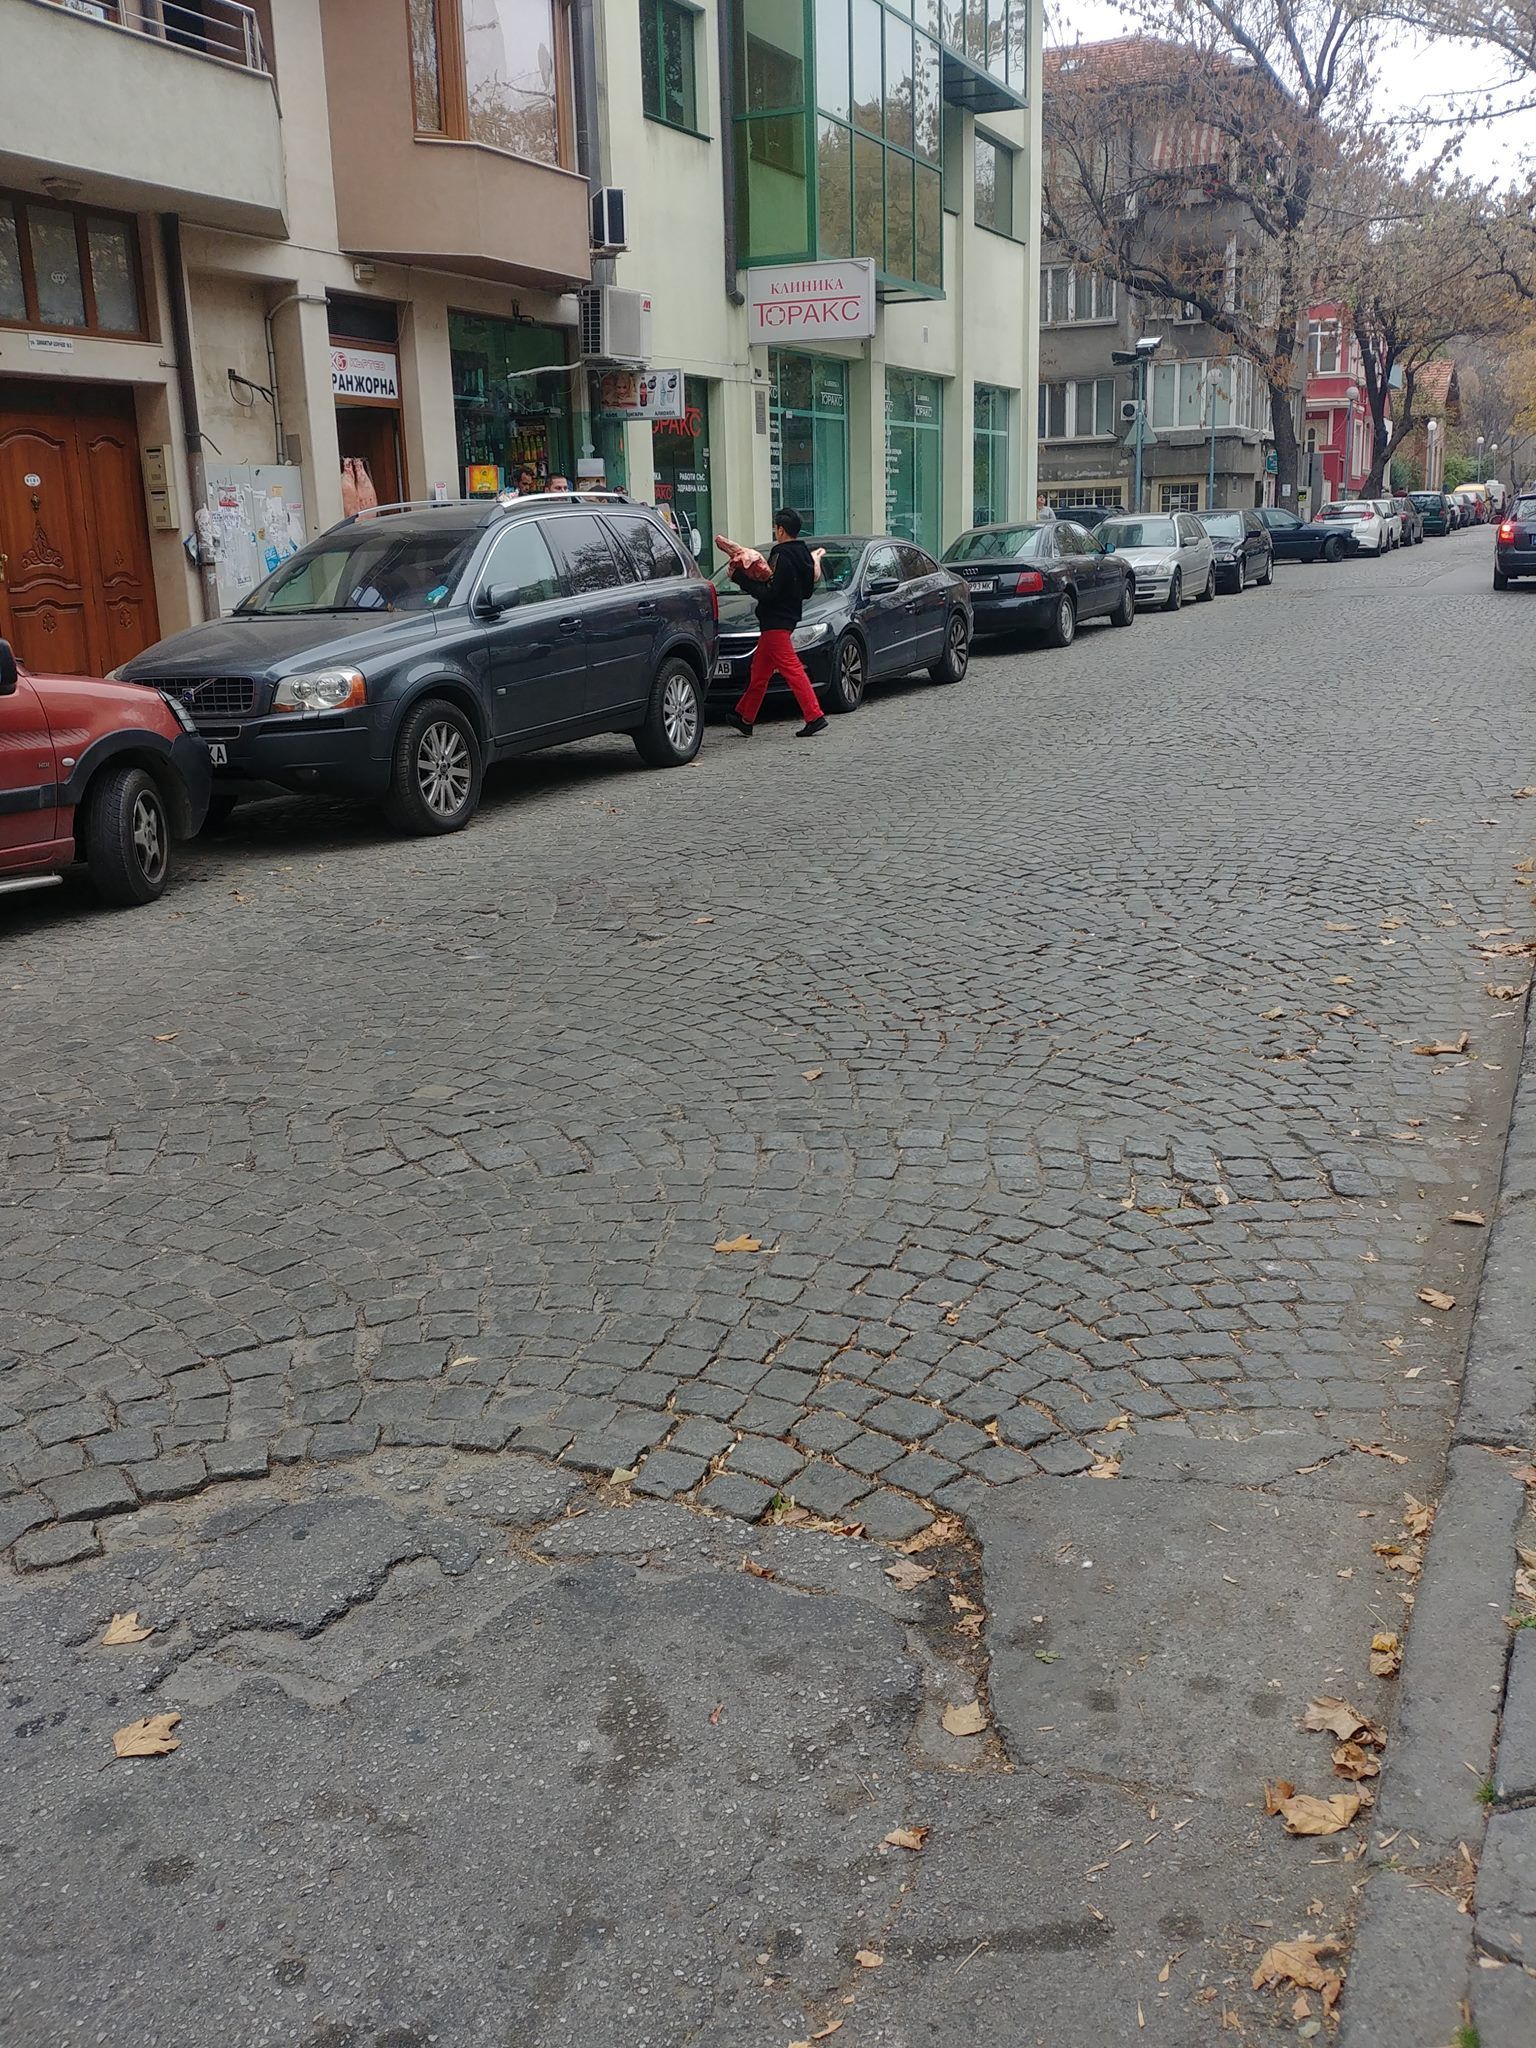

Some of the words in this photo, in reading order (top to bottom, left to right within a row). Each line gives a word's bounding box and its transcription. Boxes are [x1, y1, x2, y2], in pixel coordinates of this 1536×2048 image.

[770, 278, 844, 295] КЛИНИКА
[753, 295, 861, 327] ТОРАКС
[331, 373, 396, 396] РАНЖОРНА
[652, 407, 703, 437] РАКС
[718, 663, 730, 674] AB
